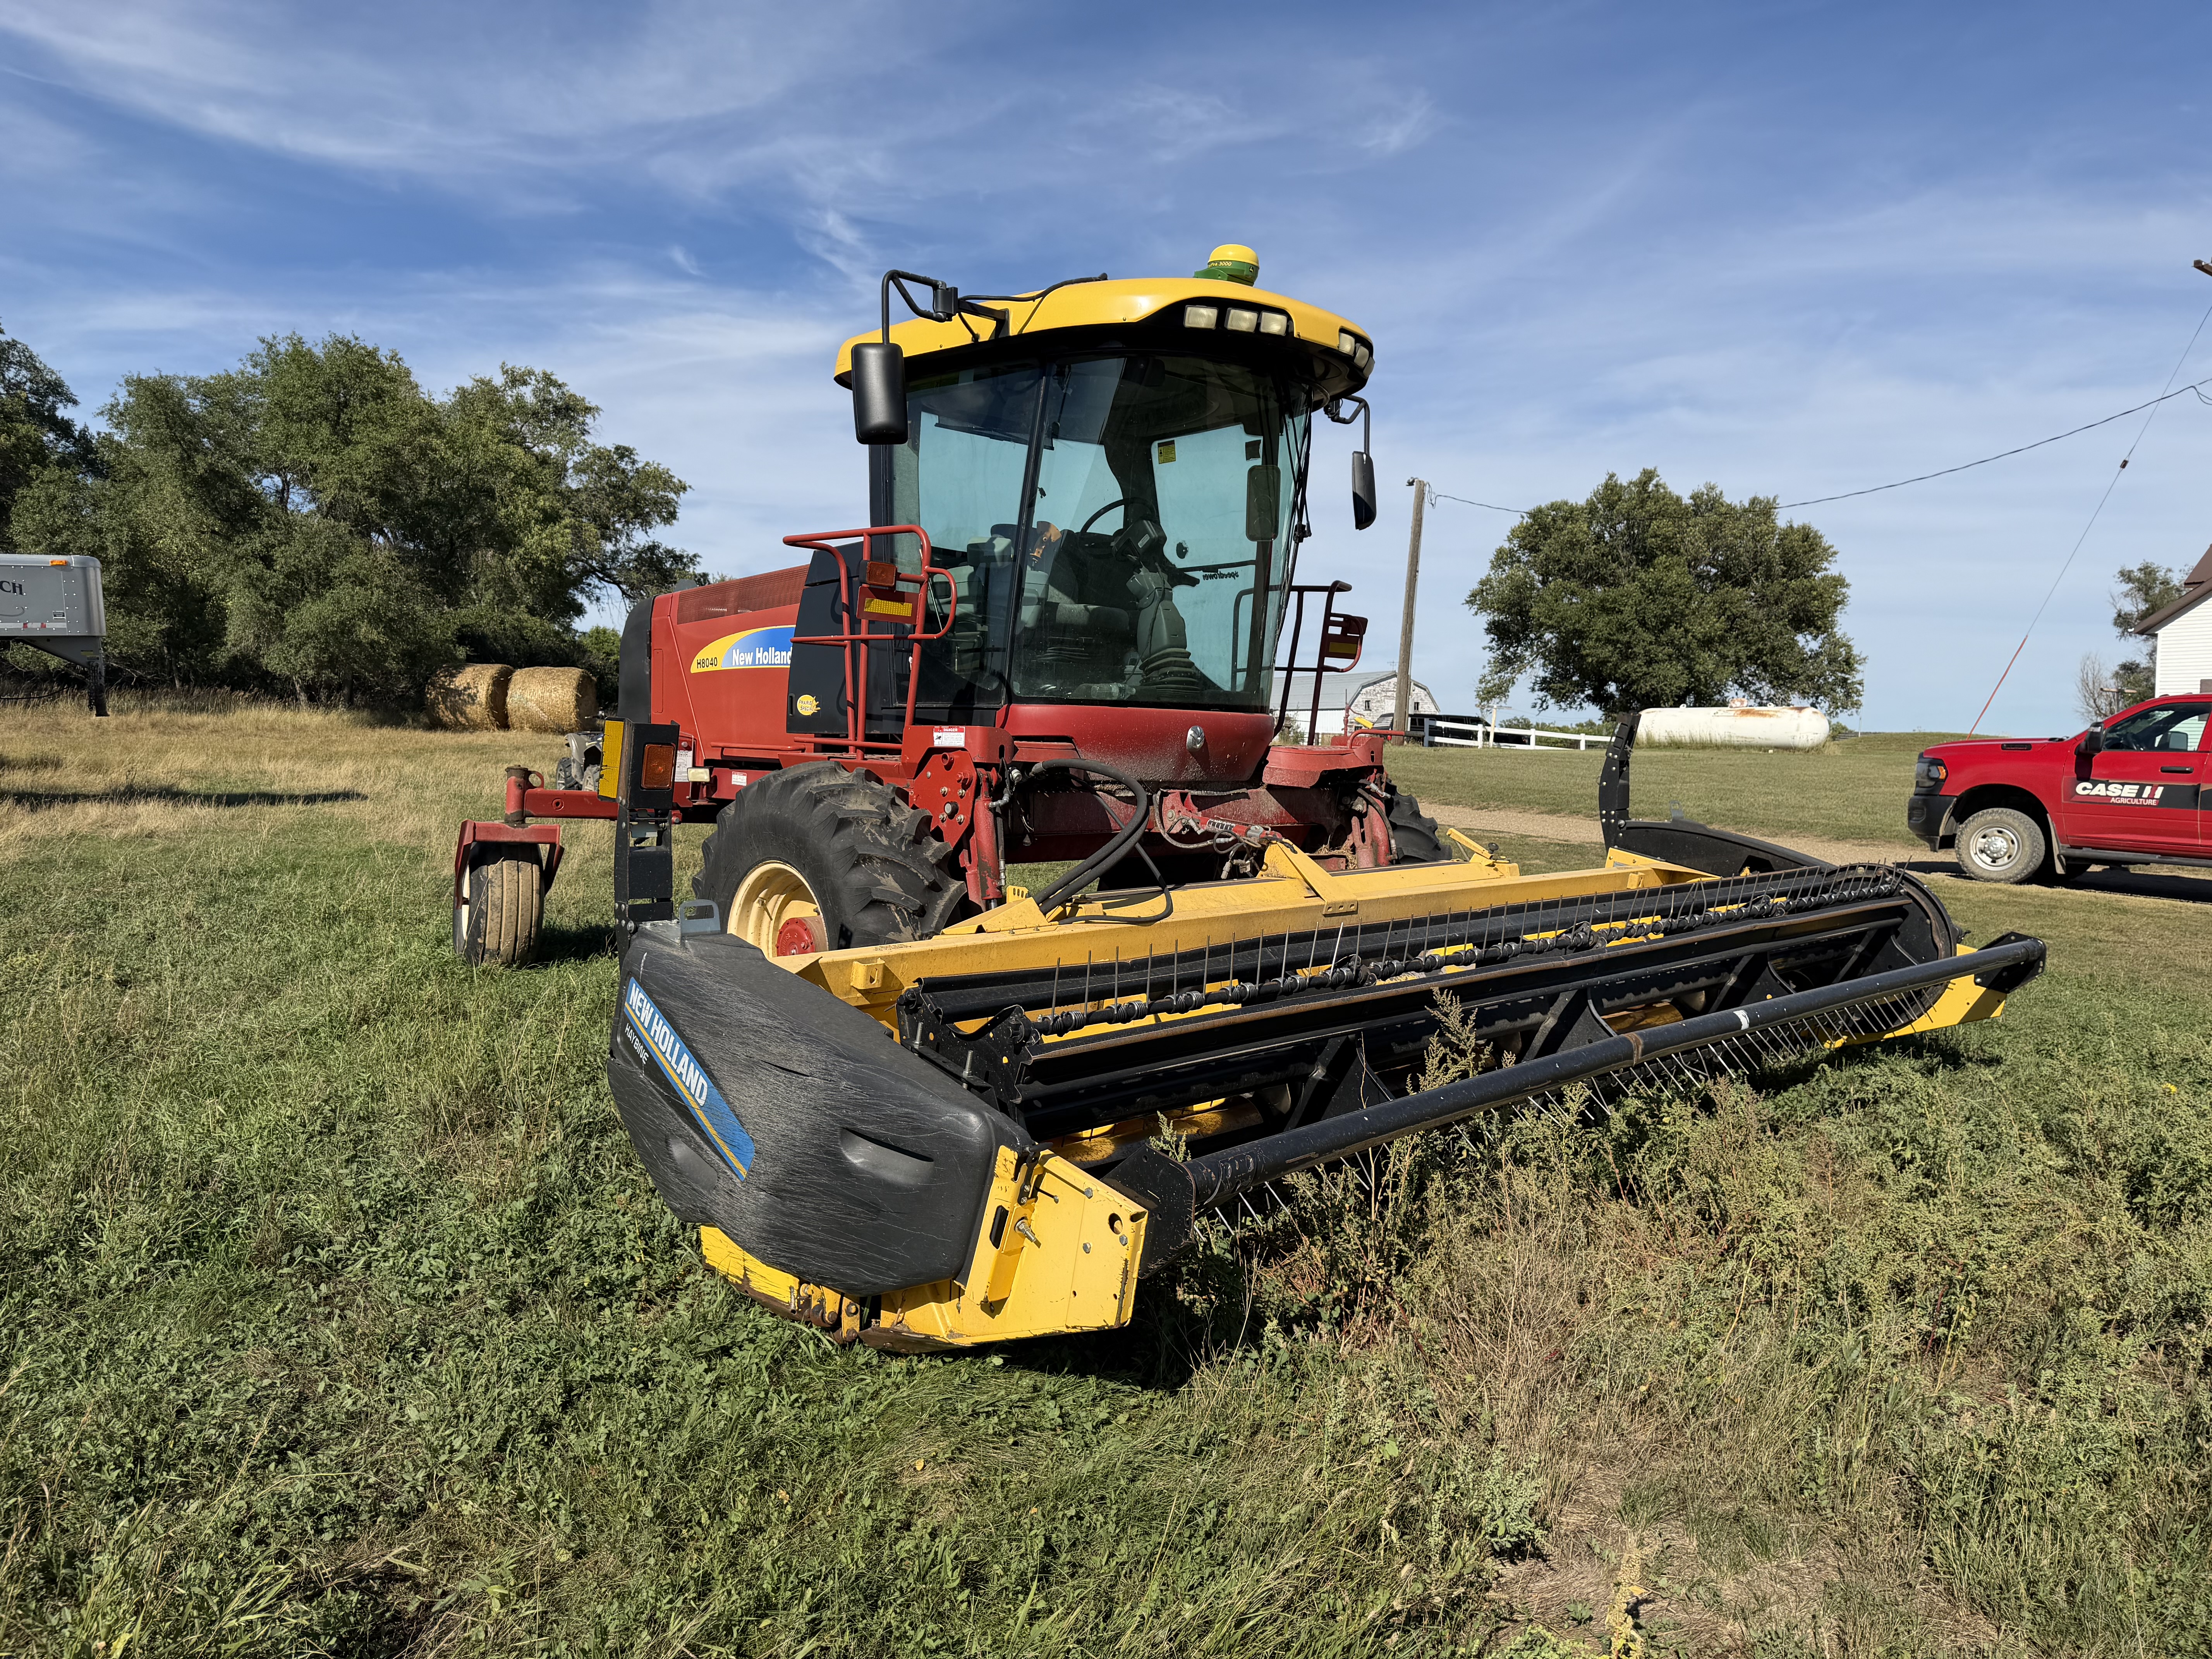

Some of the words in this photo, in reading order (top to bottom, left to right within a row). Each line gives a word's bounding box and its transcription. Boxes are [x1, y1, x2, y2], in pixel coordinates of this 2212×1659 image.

[697, 657, 718, 669] H8040
[732, 649, 753, 666] New
[2076, 782, 2140, 797] CASE
[2111, 797, 2157, 805] AGRICULTURE
[625, 1023, 649, 1065] HAYBINE
[629, 983, 654, 1029] NEW
[651, 1013, 708, 1106] HOLLAND
